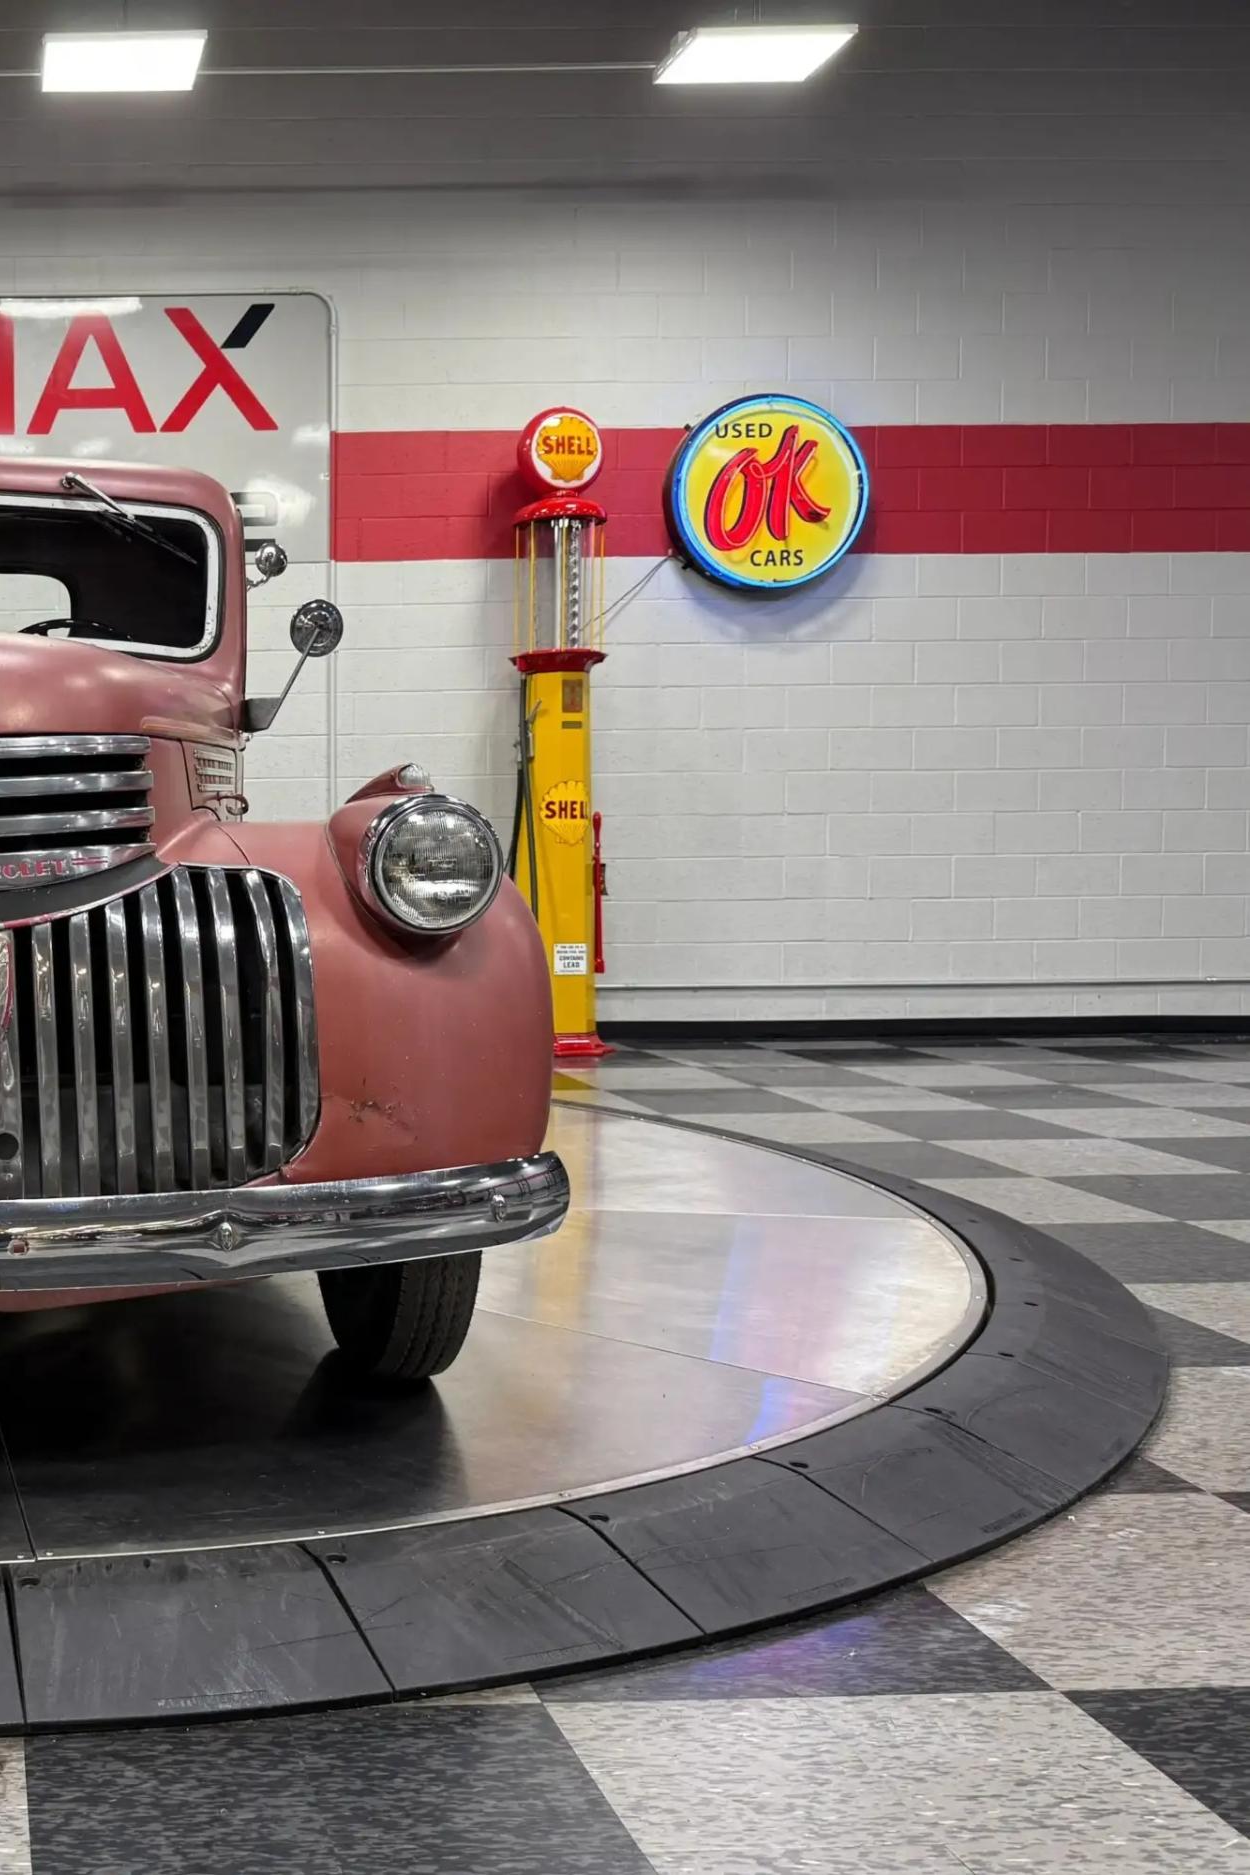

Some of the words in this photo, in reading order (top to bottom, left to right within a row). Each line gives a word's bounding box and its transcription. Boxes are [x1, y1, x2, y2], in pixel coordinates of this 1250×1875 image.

[715, 423, 773, 438] USED
[541, 435, 594, 455] SHELL
[704, 425, 831, 552] OK
[750, 549, 804, 567] CARS
